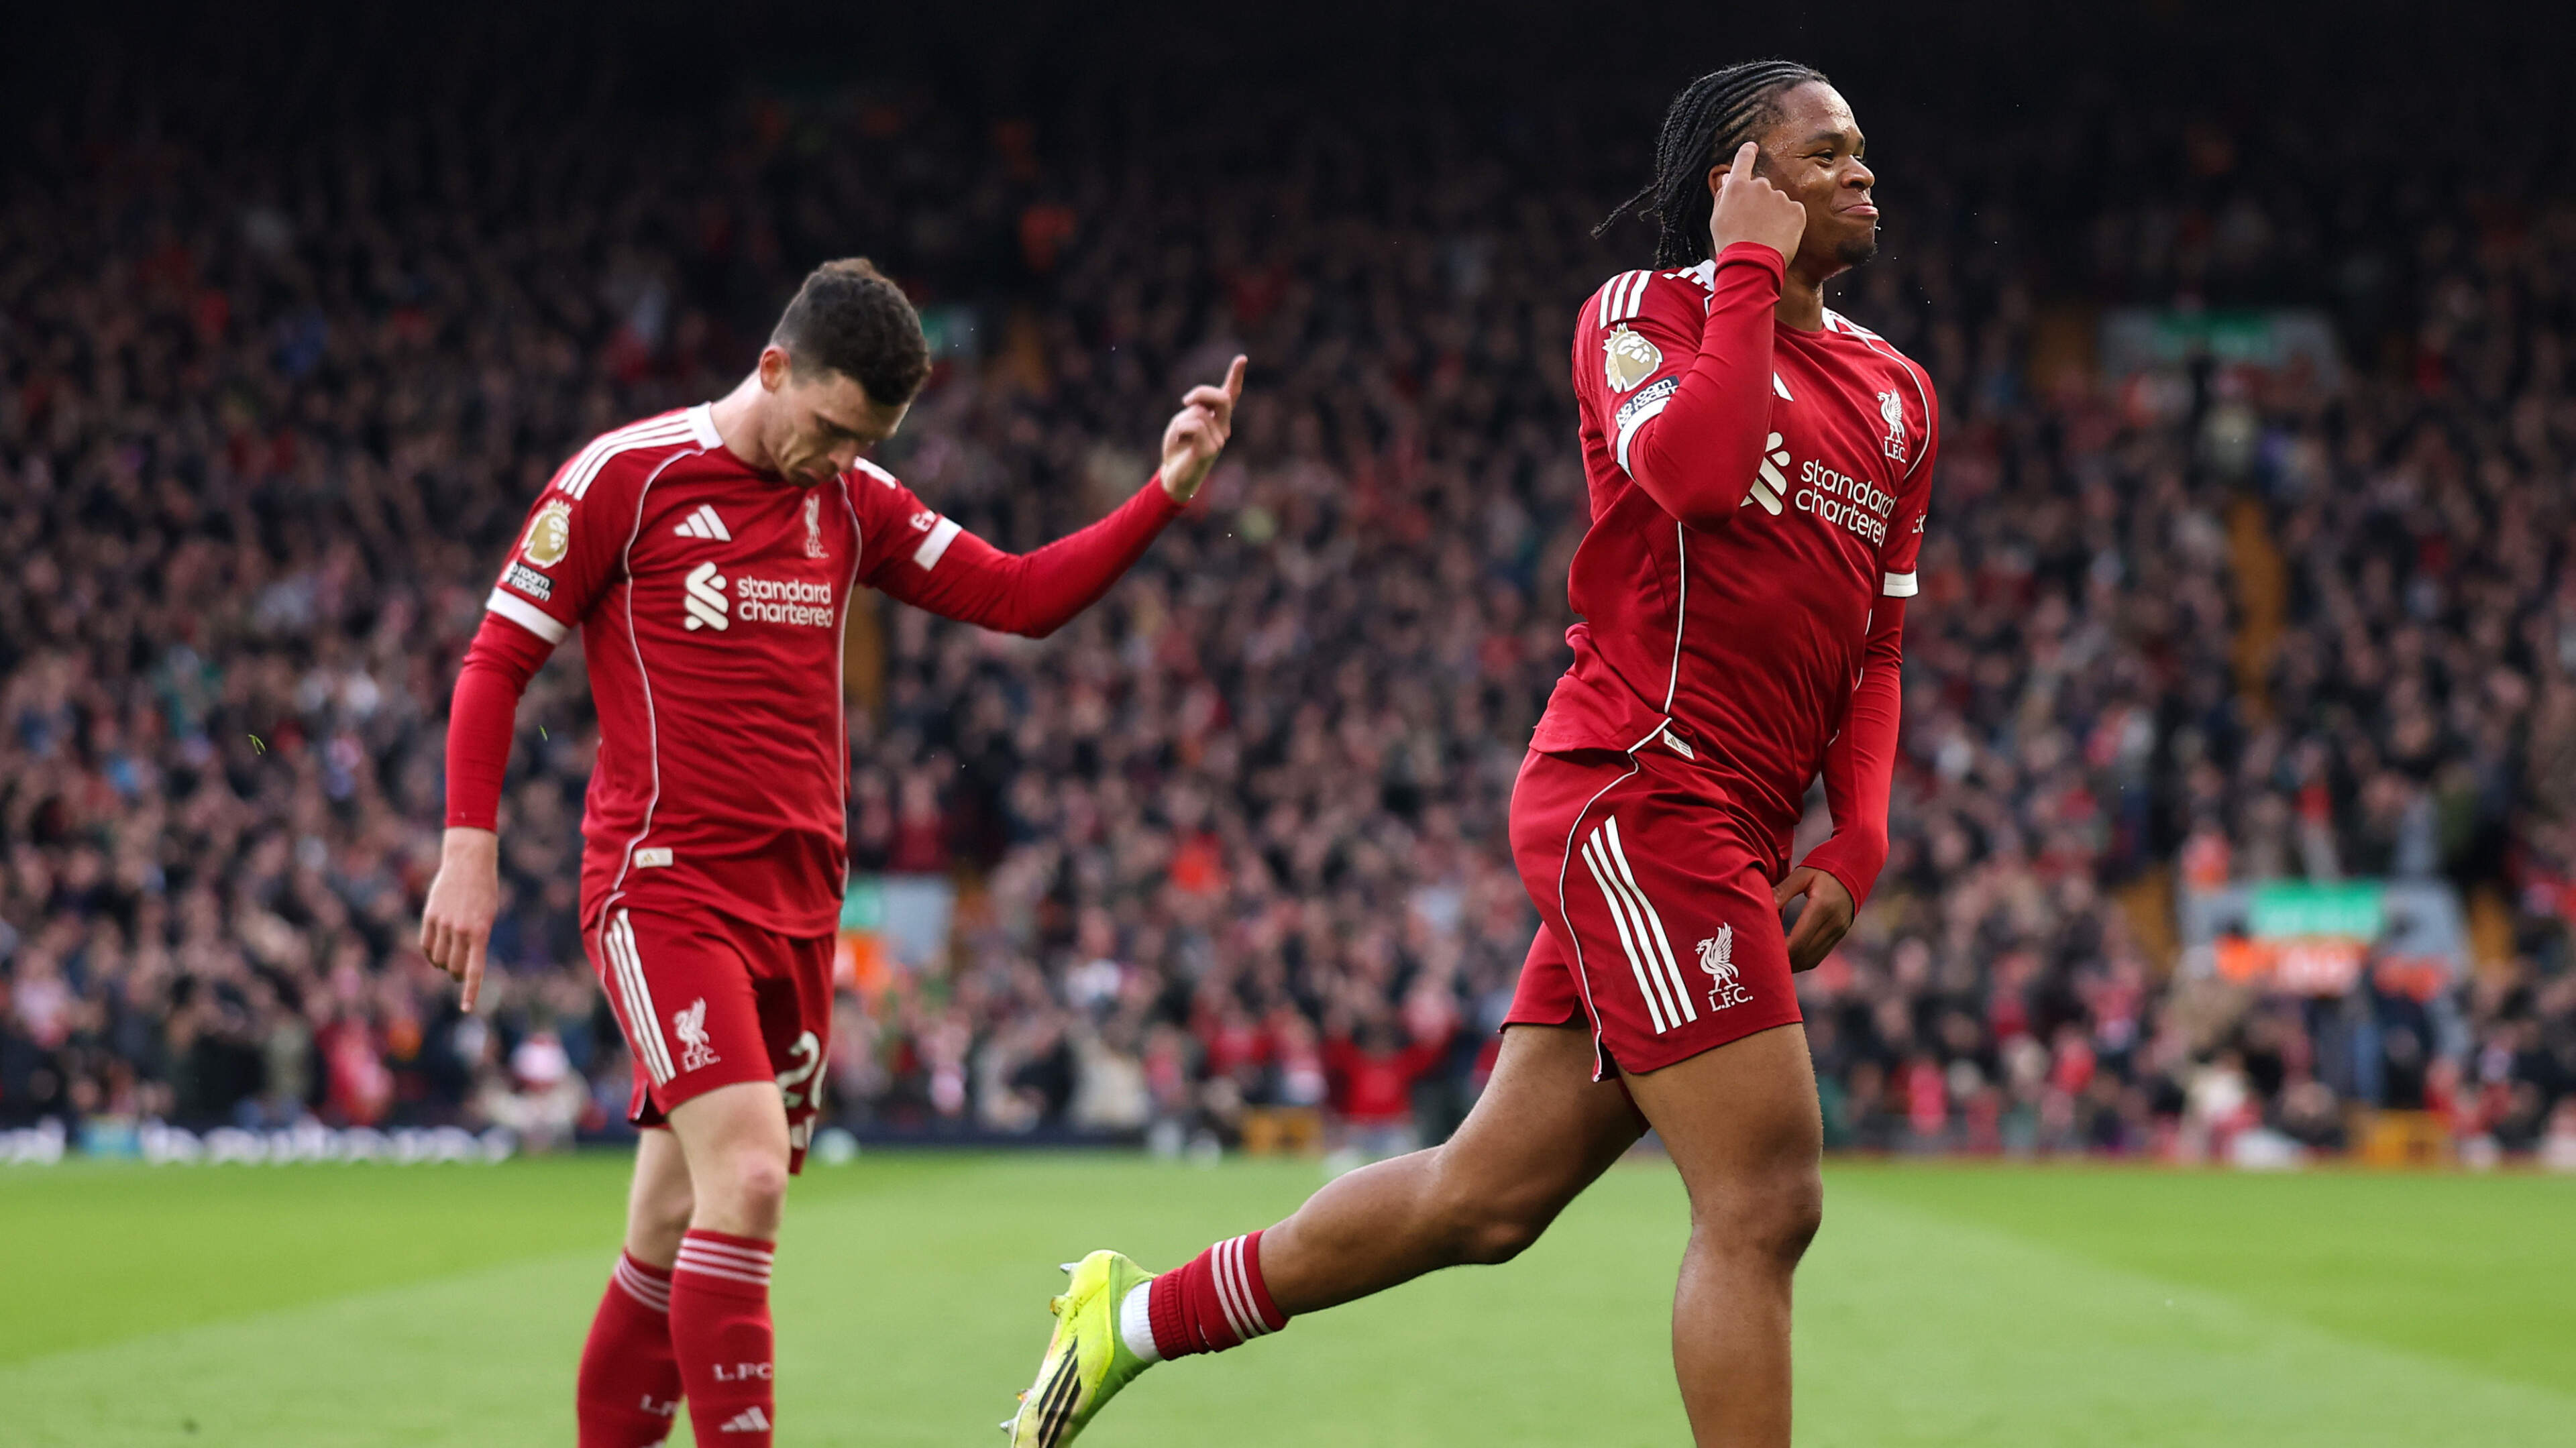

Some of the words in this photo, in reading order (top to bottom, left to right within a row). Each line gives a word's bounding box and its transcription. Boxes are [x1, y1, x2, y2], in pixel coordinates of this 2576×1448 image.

[1633, 379, 1672, 404] room
[1801, 459, 1898, 519] standard
[1795, 488, 1888, 548] chartered
[518, 565, 550, 590] room
[737, 575, 832, 605] standard
[739, 598, 834, 628] chartered
[1708, 987, 1754, 1012] L.F.C.
